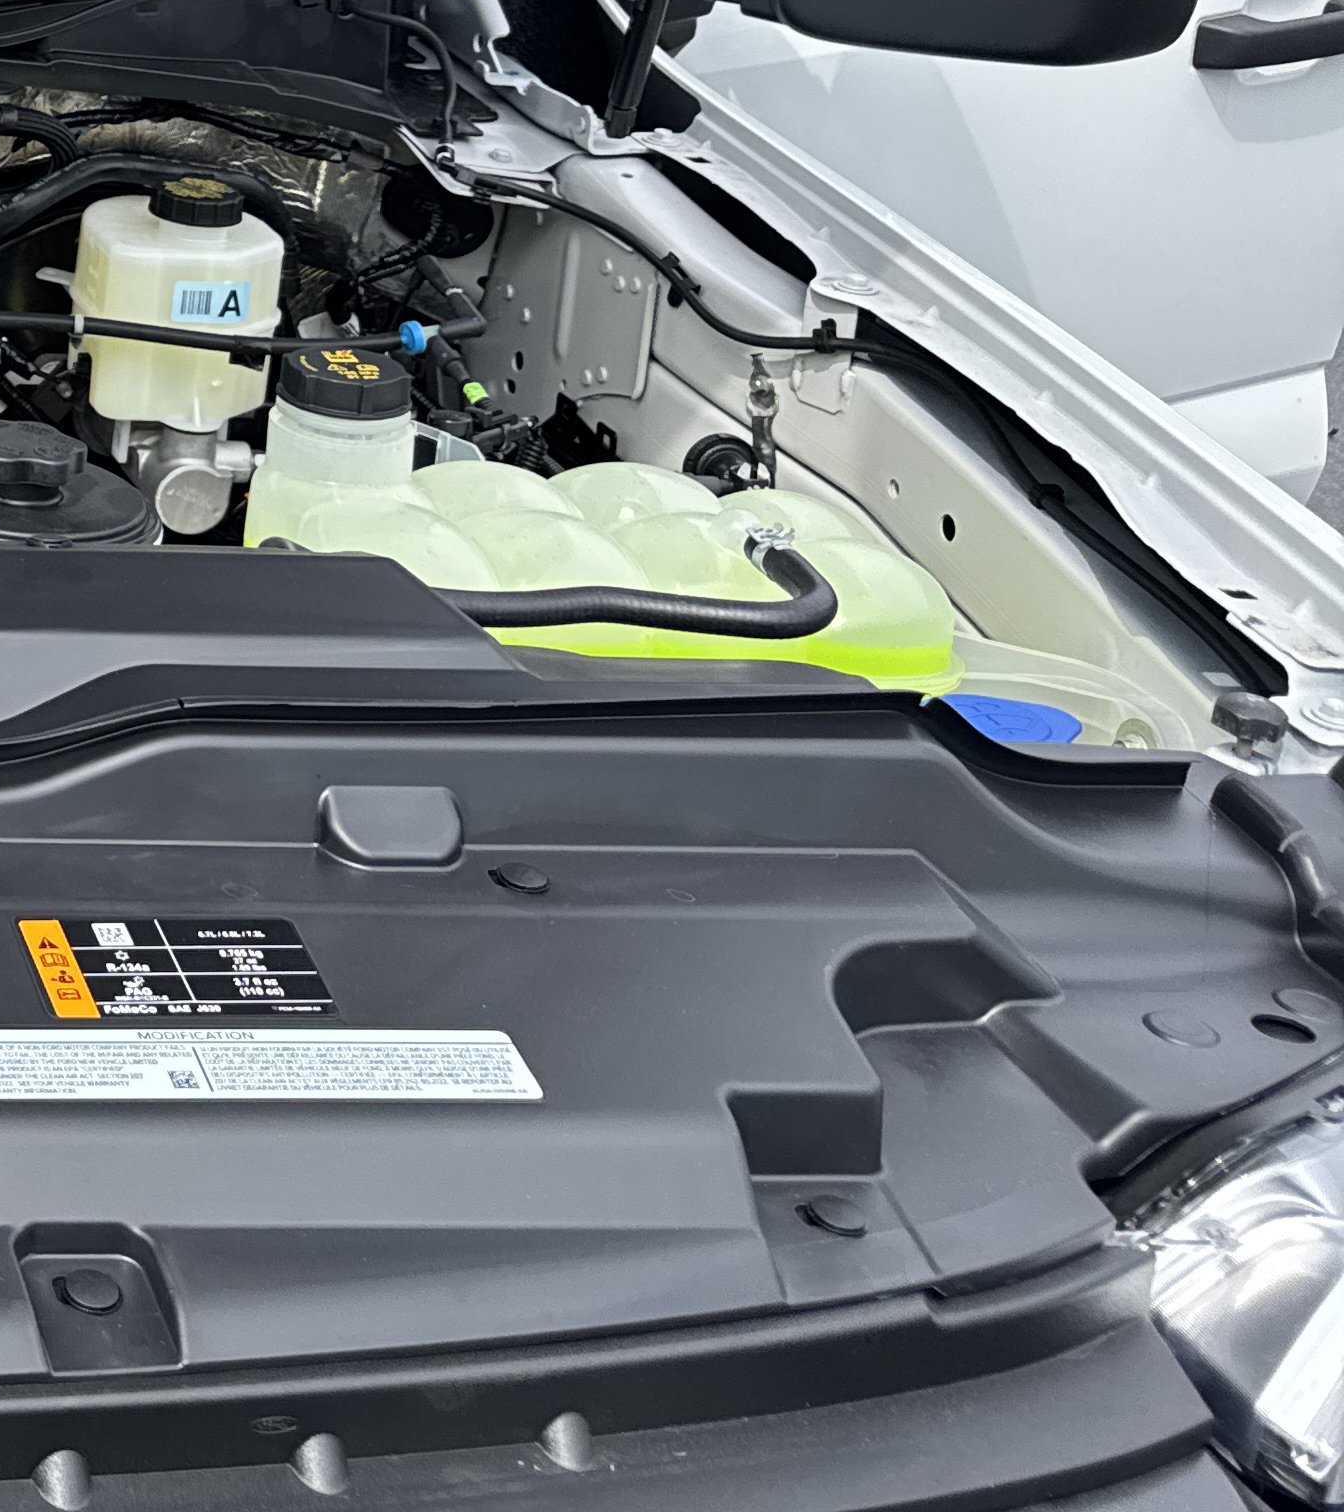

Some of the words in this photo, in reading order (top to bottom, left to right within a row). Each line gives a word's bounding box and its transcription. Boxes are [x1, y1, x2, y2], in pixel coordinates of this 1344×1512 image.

[217, 290, 242, 317] A
[248, 949, 264, 959] kg
[105, 962, 151, 972] R-134a
[233, 977, 250, 986] 3.7
[263, 978, 279, 986] oz
[124, 987, 153, 996] PAG
[103, 1004, 158, 1014] FoMoCo
[136, 1031, 254, 1041] MODIFICATION
